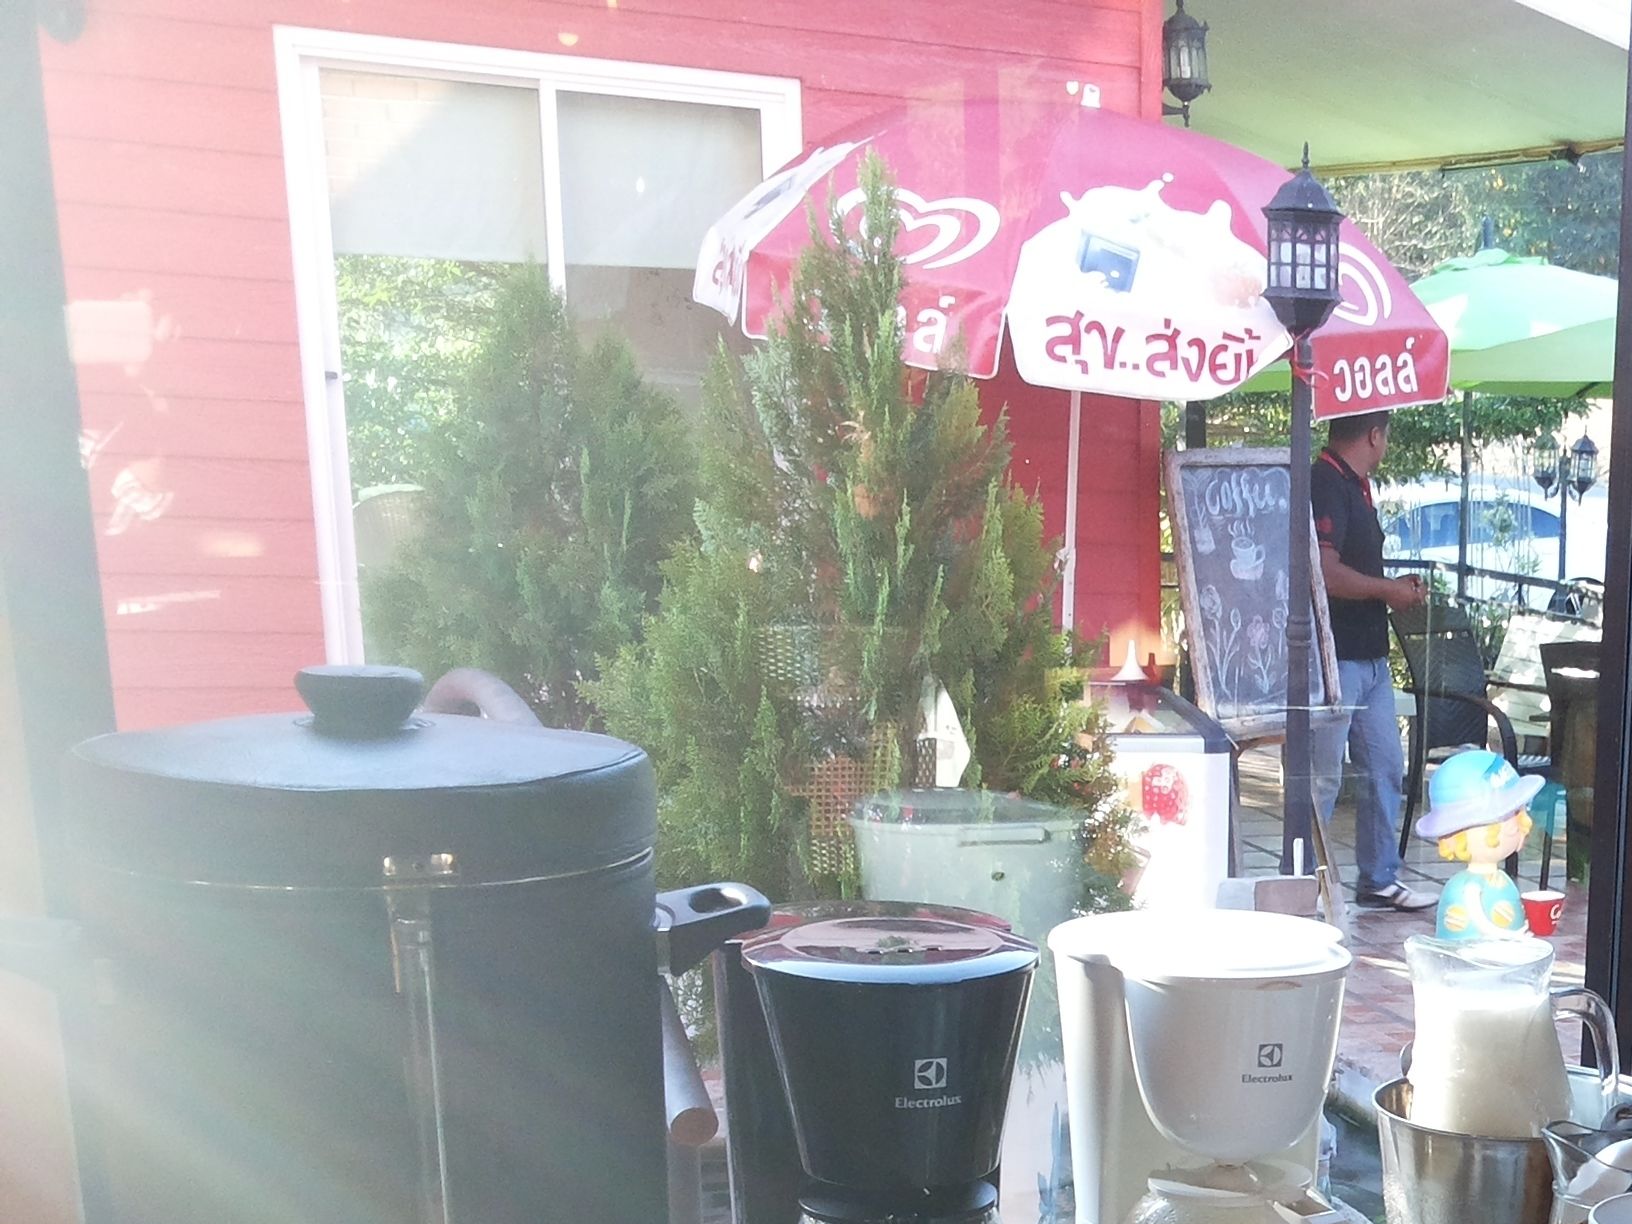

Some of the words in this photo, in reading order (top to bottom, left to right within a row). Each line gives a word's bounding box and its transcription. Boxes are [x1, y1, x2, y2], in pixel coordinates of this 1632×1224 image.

[1333, 336, 1419, 402] วอลล์
[1242, 1073, 1293, 1084] Electrolux
[895, 1095, 962, 1109] Electrolux
